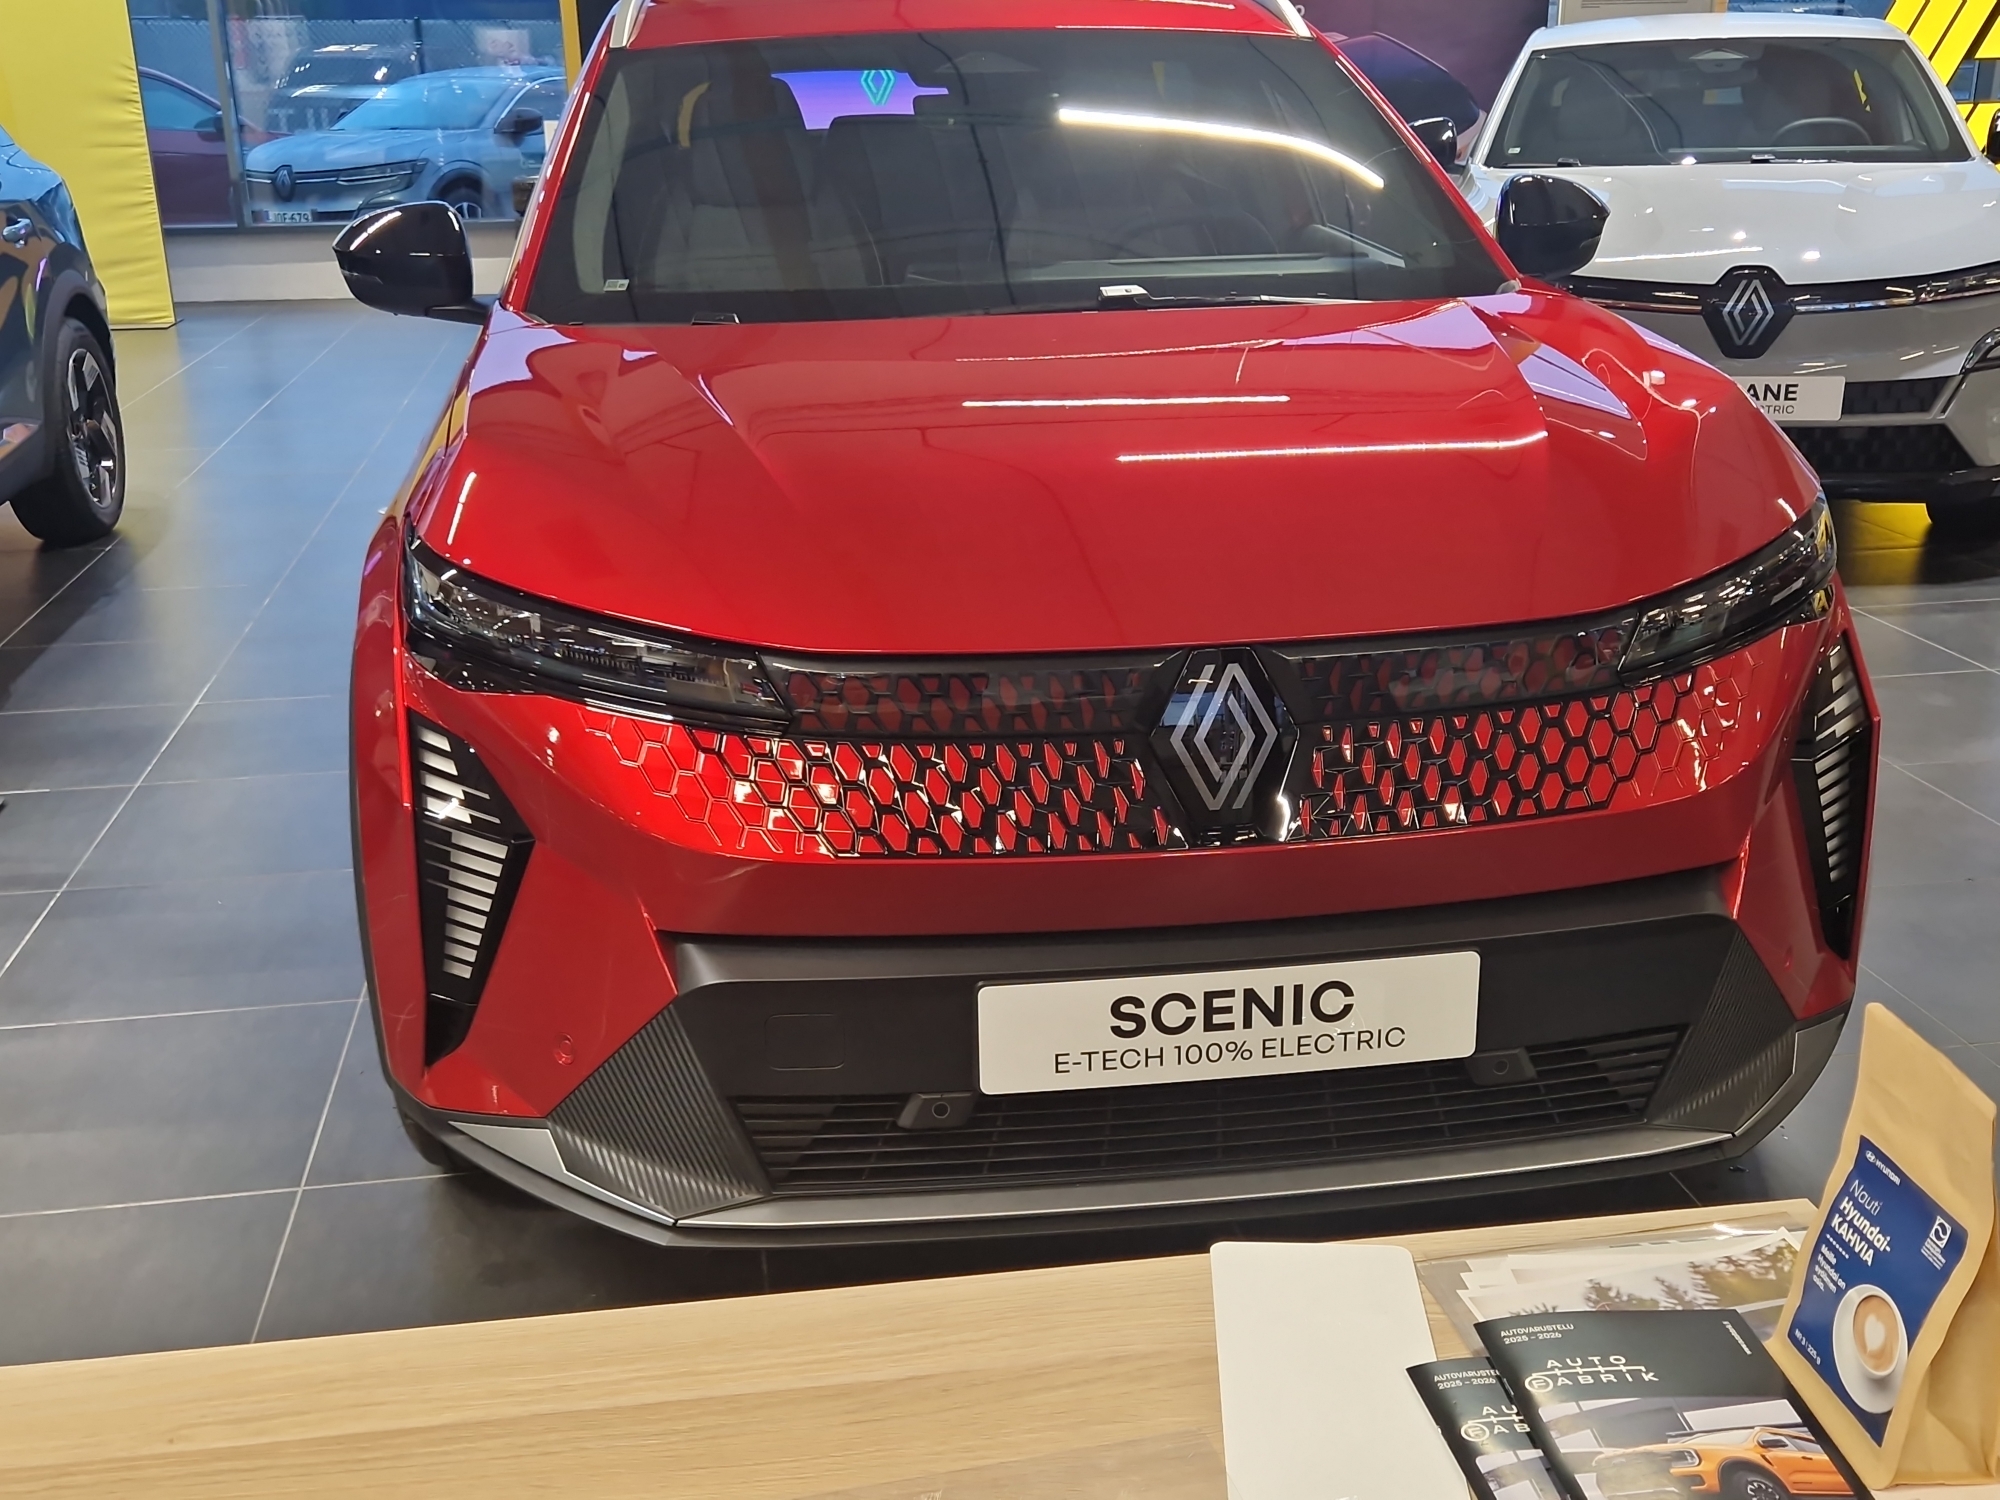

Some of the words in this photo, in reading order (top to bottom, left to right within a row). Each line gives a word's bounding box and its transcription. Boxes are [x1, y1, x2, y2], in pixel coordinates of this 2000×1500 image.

[1109, 980, 1355, 1039] SCENIC
[1054, 1046, 1165, 1074] E-TECH
[1173, 1040, 1253, 1066] 100%
[1261, 1026, 1407, 1059] ELECTRIC
[1875, 1159, 1901, 1186] HYUNDAI
[1850, 1179, 1883, 1216] Nauti
[1839, 1196, 1891, 1252] Hyundai-
[1831, 1213, 1875, 1267] KAHVIA
[1500, 1323, 1575, 1337] AUTOVARUSTELU
[1503, 1335, 1529, 1345] 2025
[1537, 1331, 1562, 1340] 2026
[1546, 1355, 1626, 1369] AUTO
[1437, 1380, 1463, 1390] 2025
[1471, 1377, 1496, 1385] 2026
[1524, 1372, 1660, 1393] FABRIK
